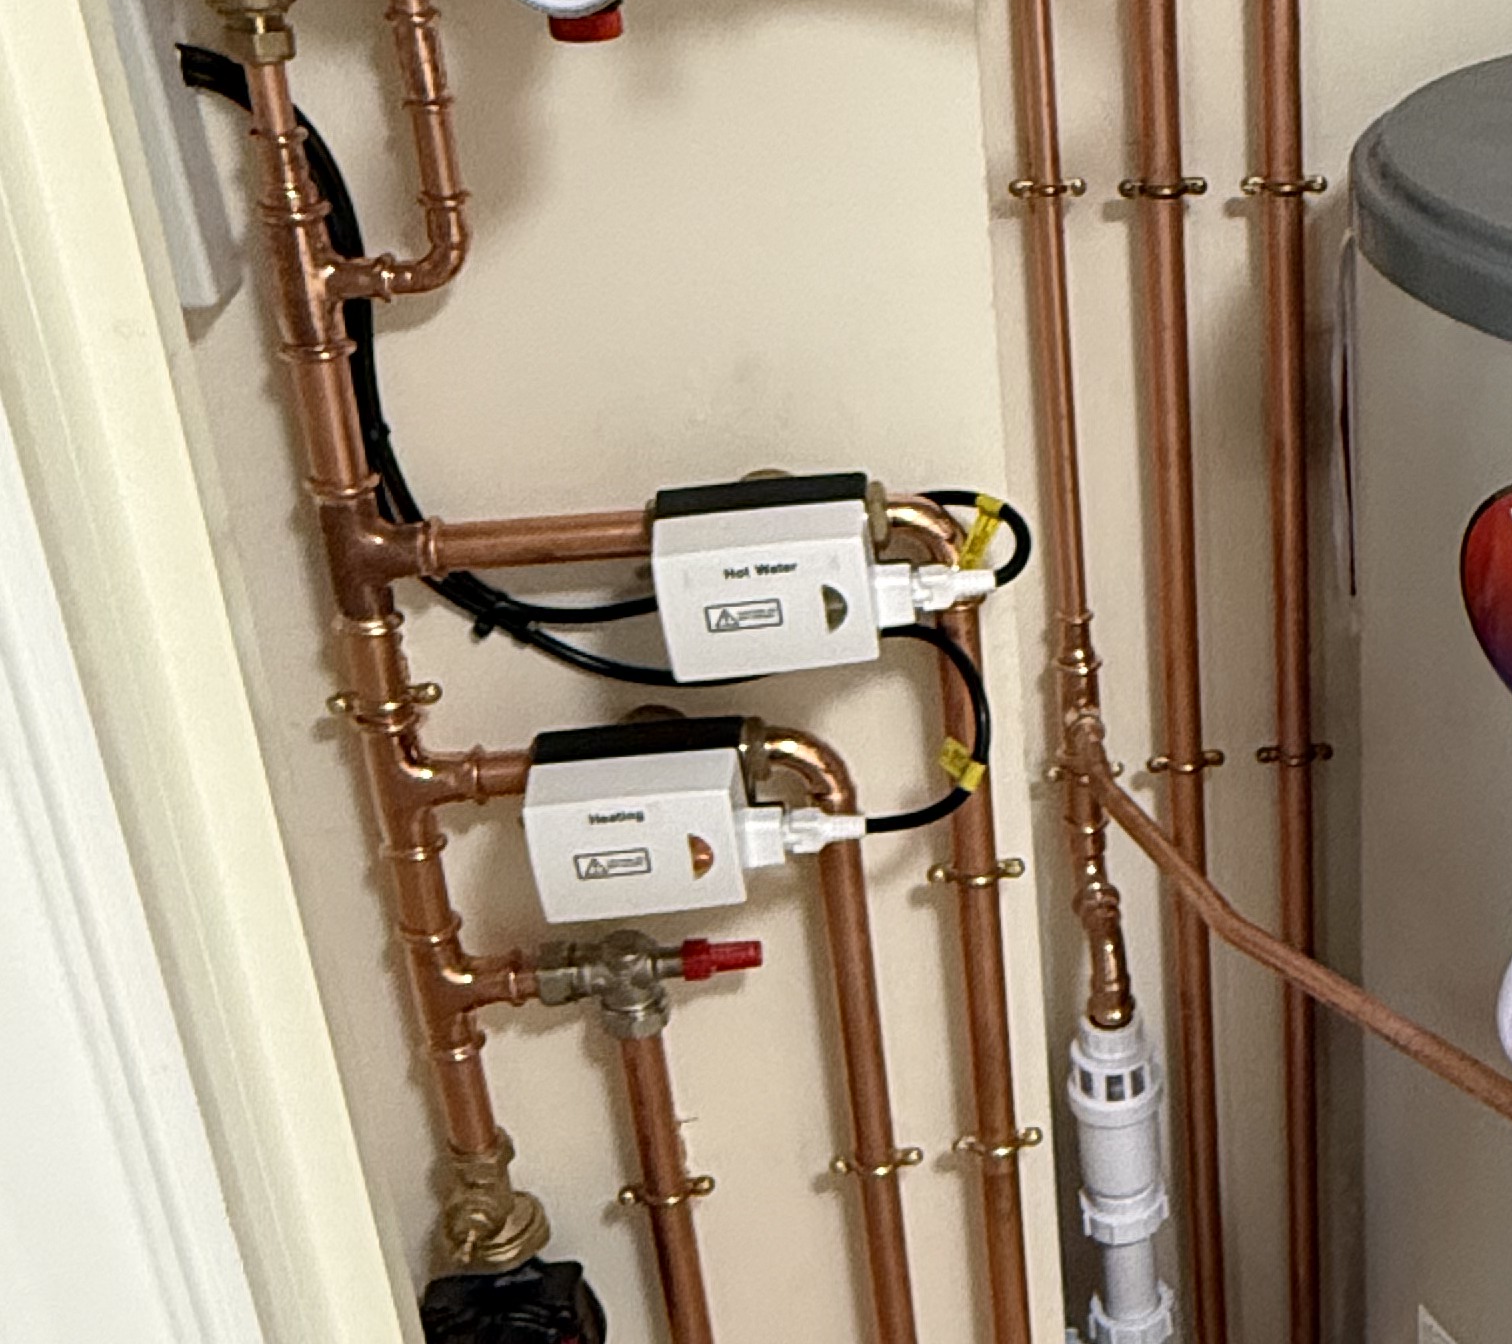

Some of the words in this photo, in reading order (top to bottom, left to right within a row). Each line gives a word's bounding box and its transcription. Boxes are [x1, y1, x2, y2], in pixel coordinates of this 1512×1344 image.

[722, 566, 750, 580] Hot
[754, 562, 798, 576] Water
[588, 810, 645, 825] Heating
